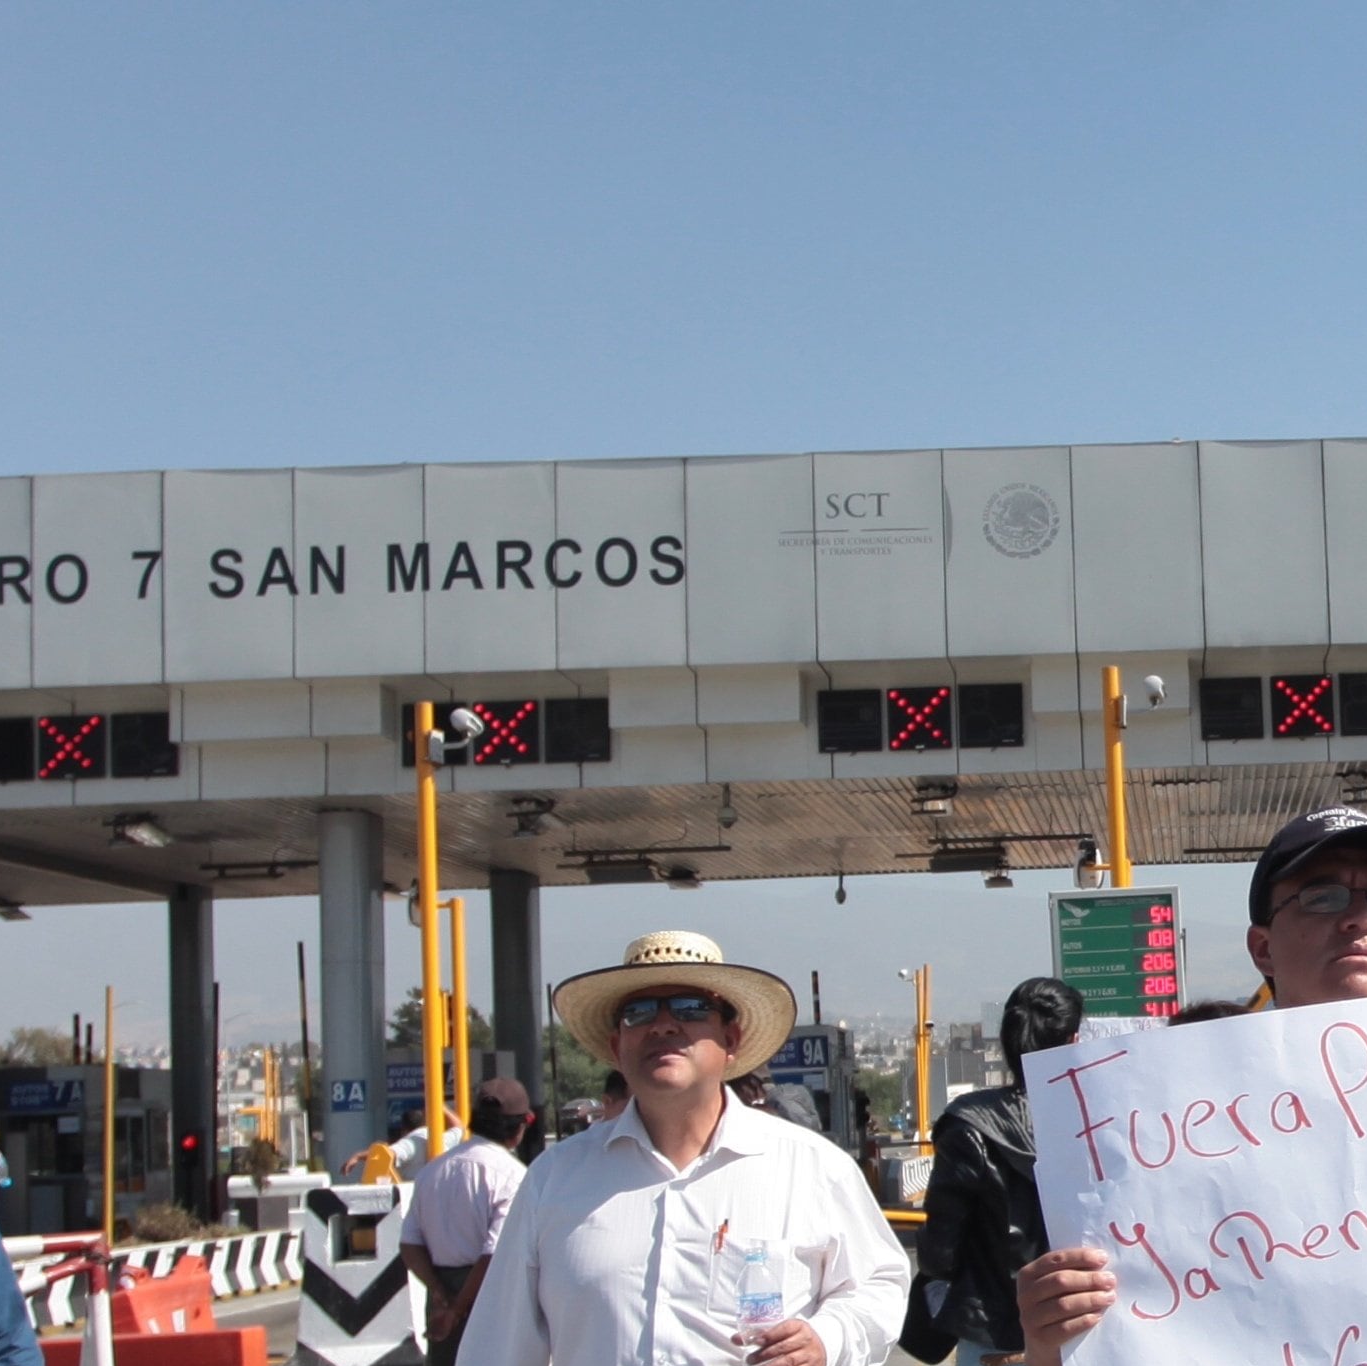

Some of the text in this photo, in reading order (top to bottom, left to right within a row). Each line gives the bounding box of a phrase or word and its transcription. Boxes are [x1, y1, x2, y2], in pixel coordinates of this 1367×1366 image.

[825, 492, 890, 519] SCT
[132, 550, 164, 599] 7
[210, 545, 346, 598] SAN
[386, 536, 686, 592] MARCOS
[1149, 904, 1172, 923] 54
[1148, 928, 1175, 948] 108
[1142, 952, 1176, 972] 206
[1144, 975, 1178, 996] 206
[802, 1038, 825, 1066] 9A
[1047, 1048, 1312, 1182] Fuera
